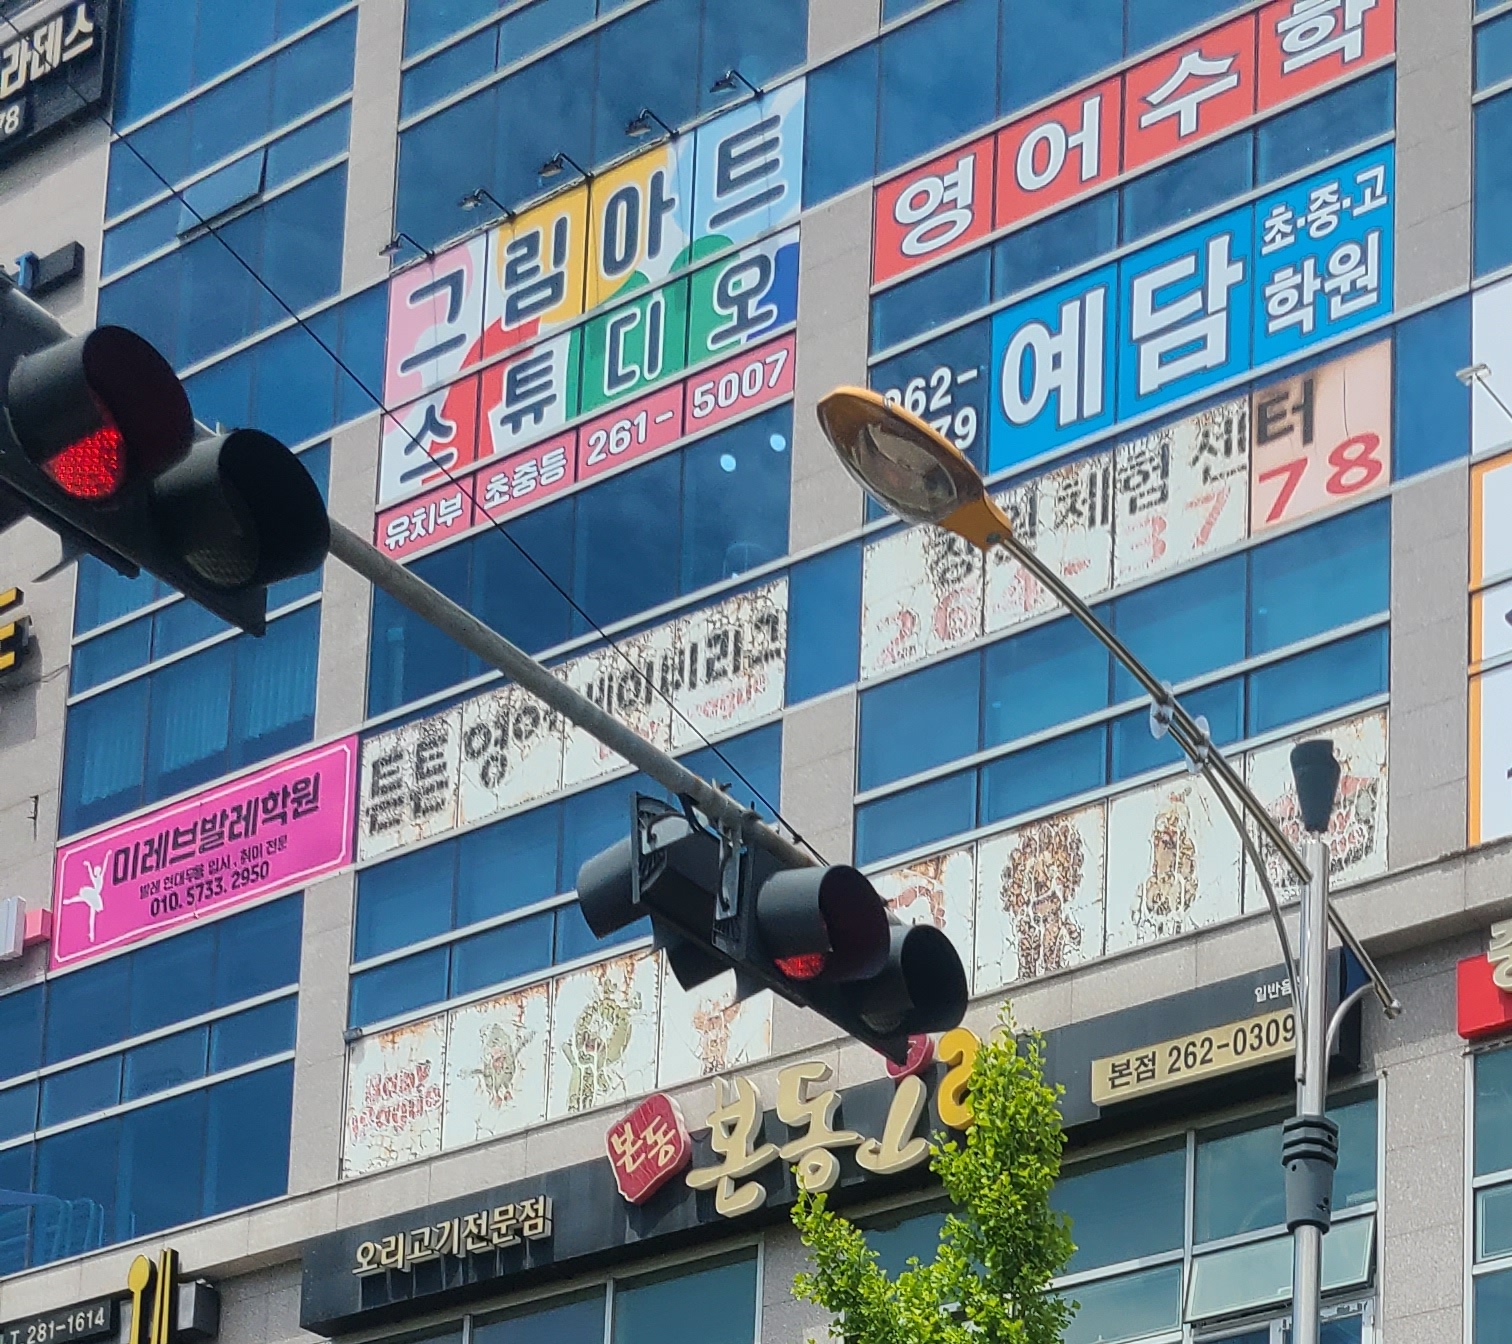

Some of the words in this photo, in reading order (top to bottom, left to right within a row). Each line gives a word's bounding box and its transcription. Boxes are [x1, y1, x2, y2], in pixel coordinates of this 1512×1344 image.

[894, 0, 1375, 256] 영어수학
[398, 114, 785, 376] 그림아트
[398, 258, 776, 484] 스튜디오
[1001, 233, 1245, 427] 예담
[1265, 231, 1380, 335] 학원
[385, 490, 464, 550] 유치부
[483, 446, 569, 511] 초중등
[231, 861, 270, 890] 2950
[1108, 1051, 1157, 1089] 본점
[1168, 1014, 1296, 1075] 262-0309
[611, 1114, 676, 1174] 본동
[352, 1195, 553, 1277] 오리고기전문점
